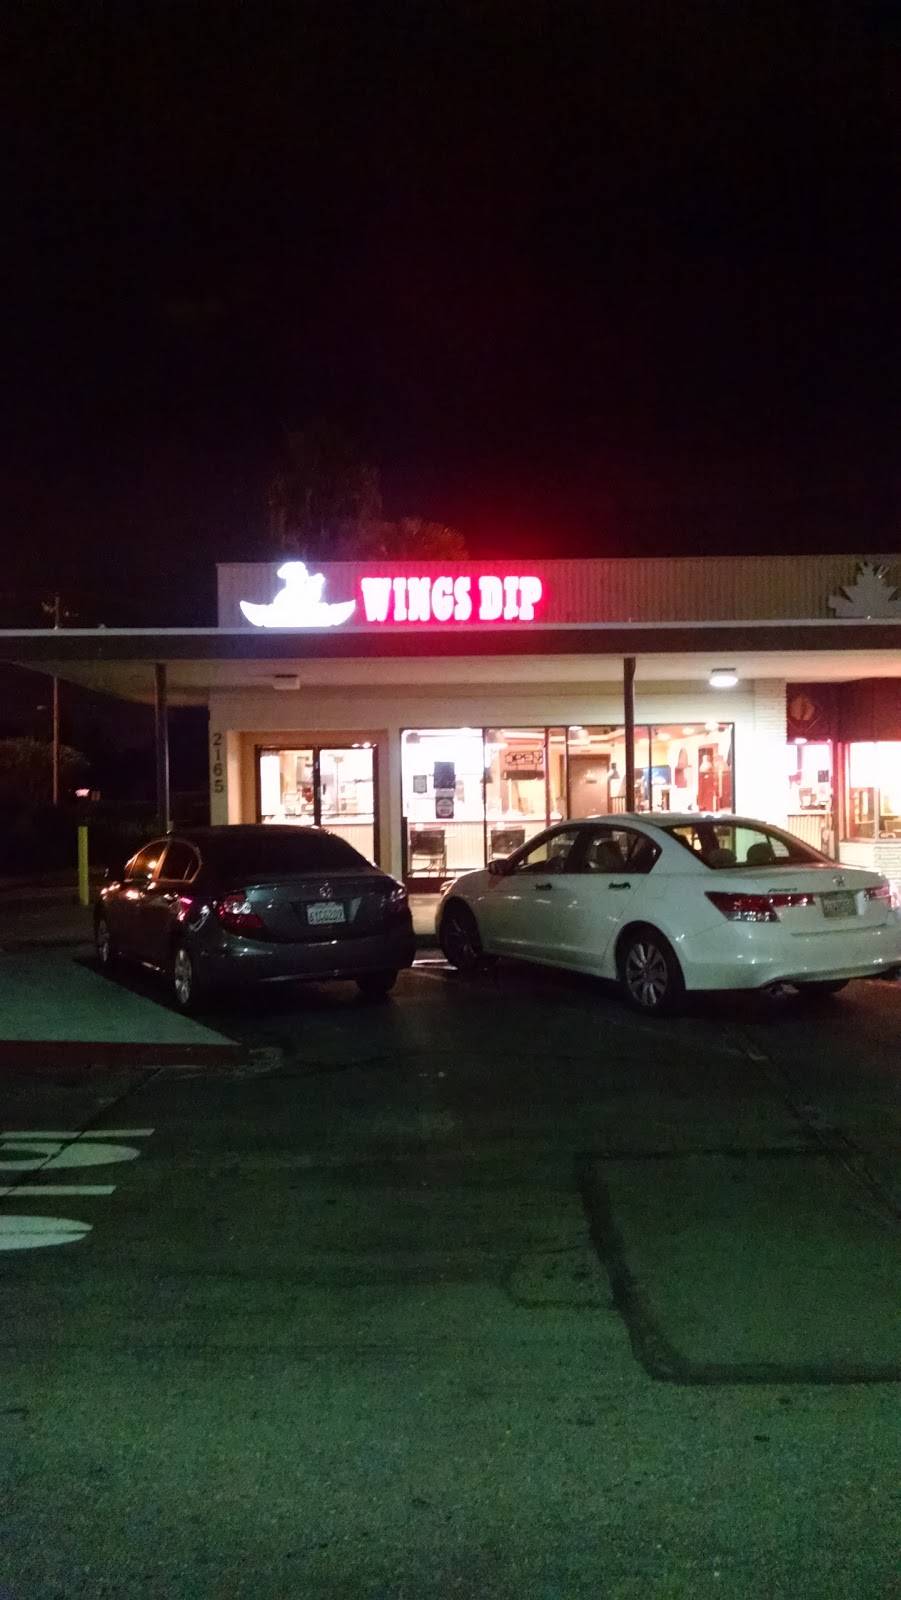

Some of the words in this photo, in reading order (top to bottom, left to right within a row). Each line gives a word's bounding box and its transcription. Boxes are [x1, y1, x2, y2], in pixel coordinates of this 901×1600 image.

[361, 576, 472, 621] WINGS
[478, 576, 542, 621] DIP
[212, 733, 224, 793] 2165
